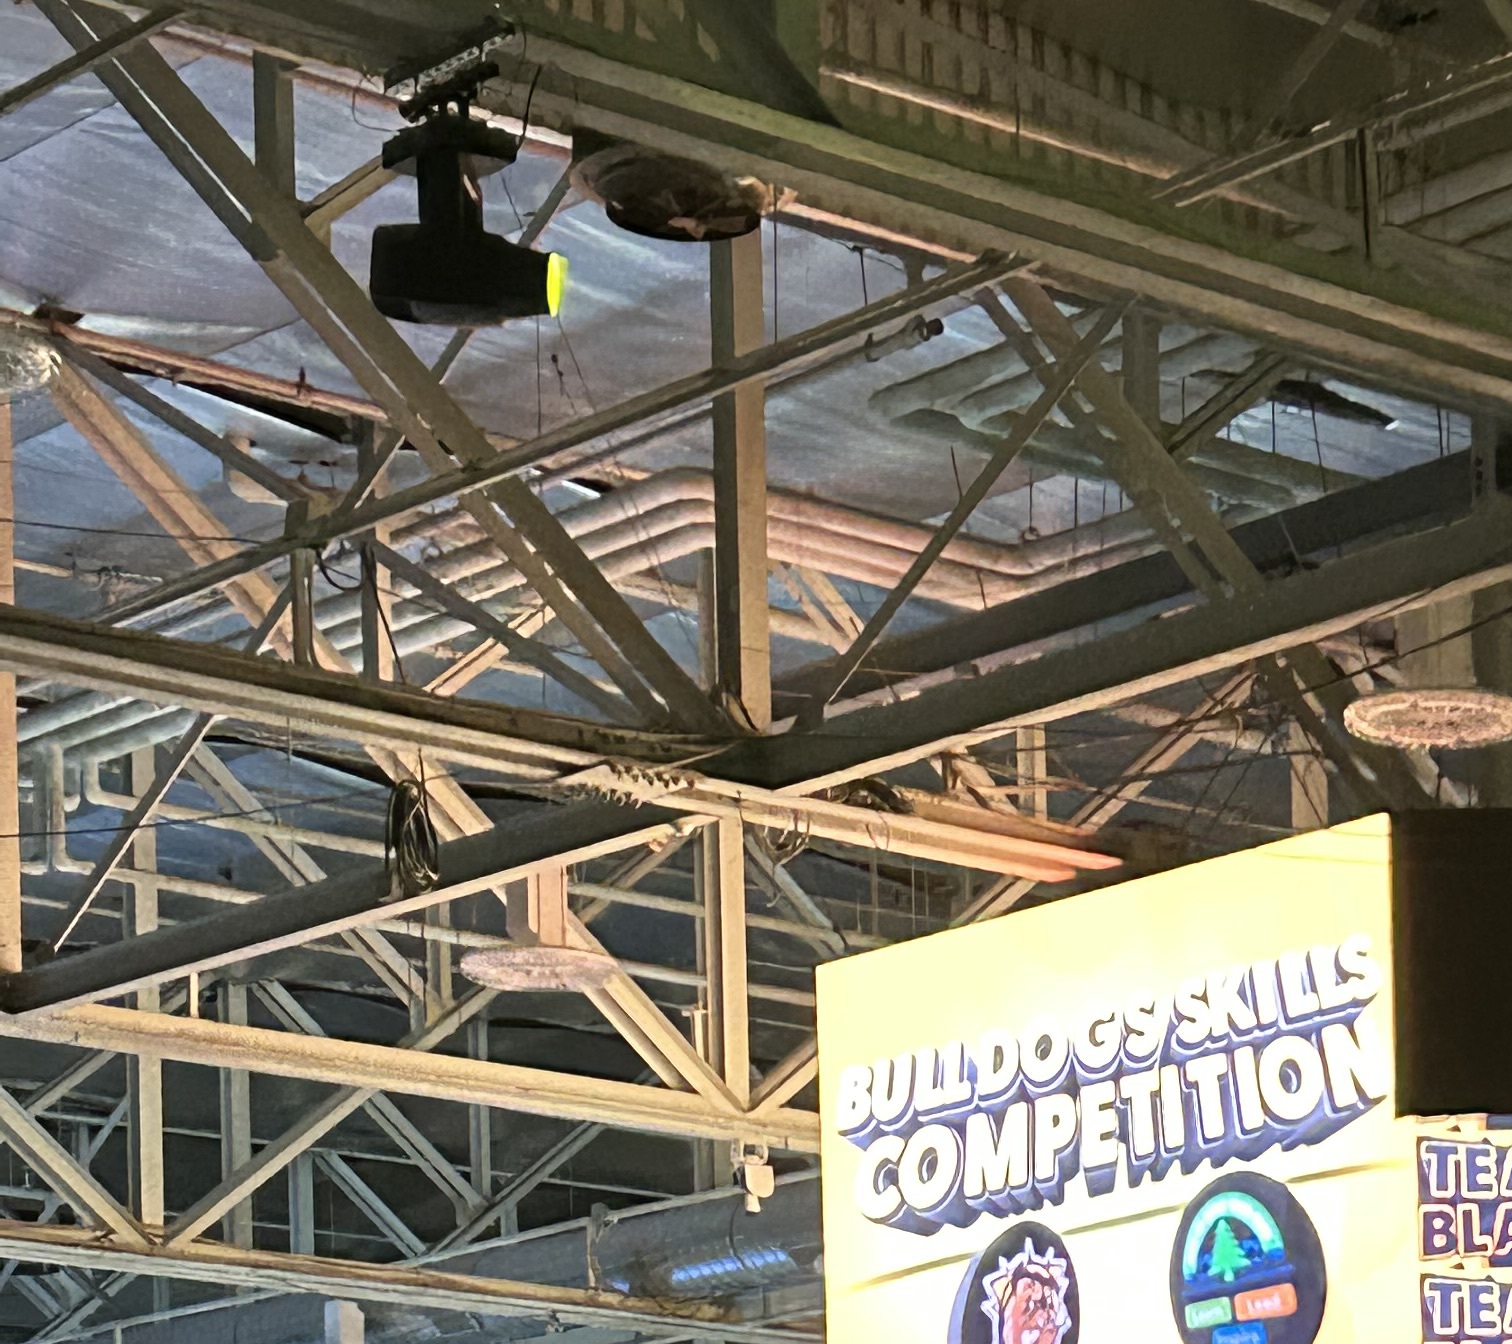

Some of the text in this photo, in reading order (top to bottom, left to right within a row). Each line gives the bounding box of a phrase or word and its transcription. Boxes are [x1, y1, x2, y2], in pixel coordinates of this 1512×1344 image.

[838, 934, 1384, 1152] BULLDOGS SKILLS
[854, 1018, 1388, 1236] COMPETITION
